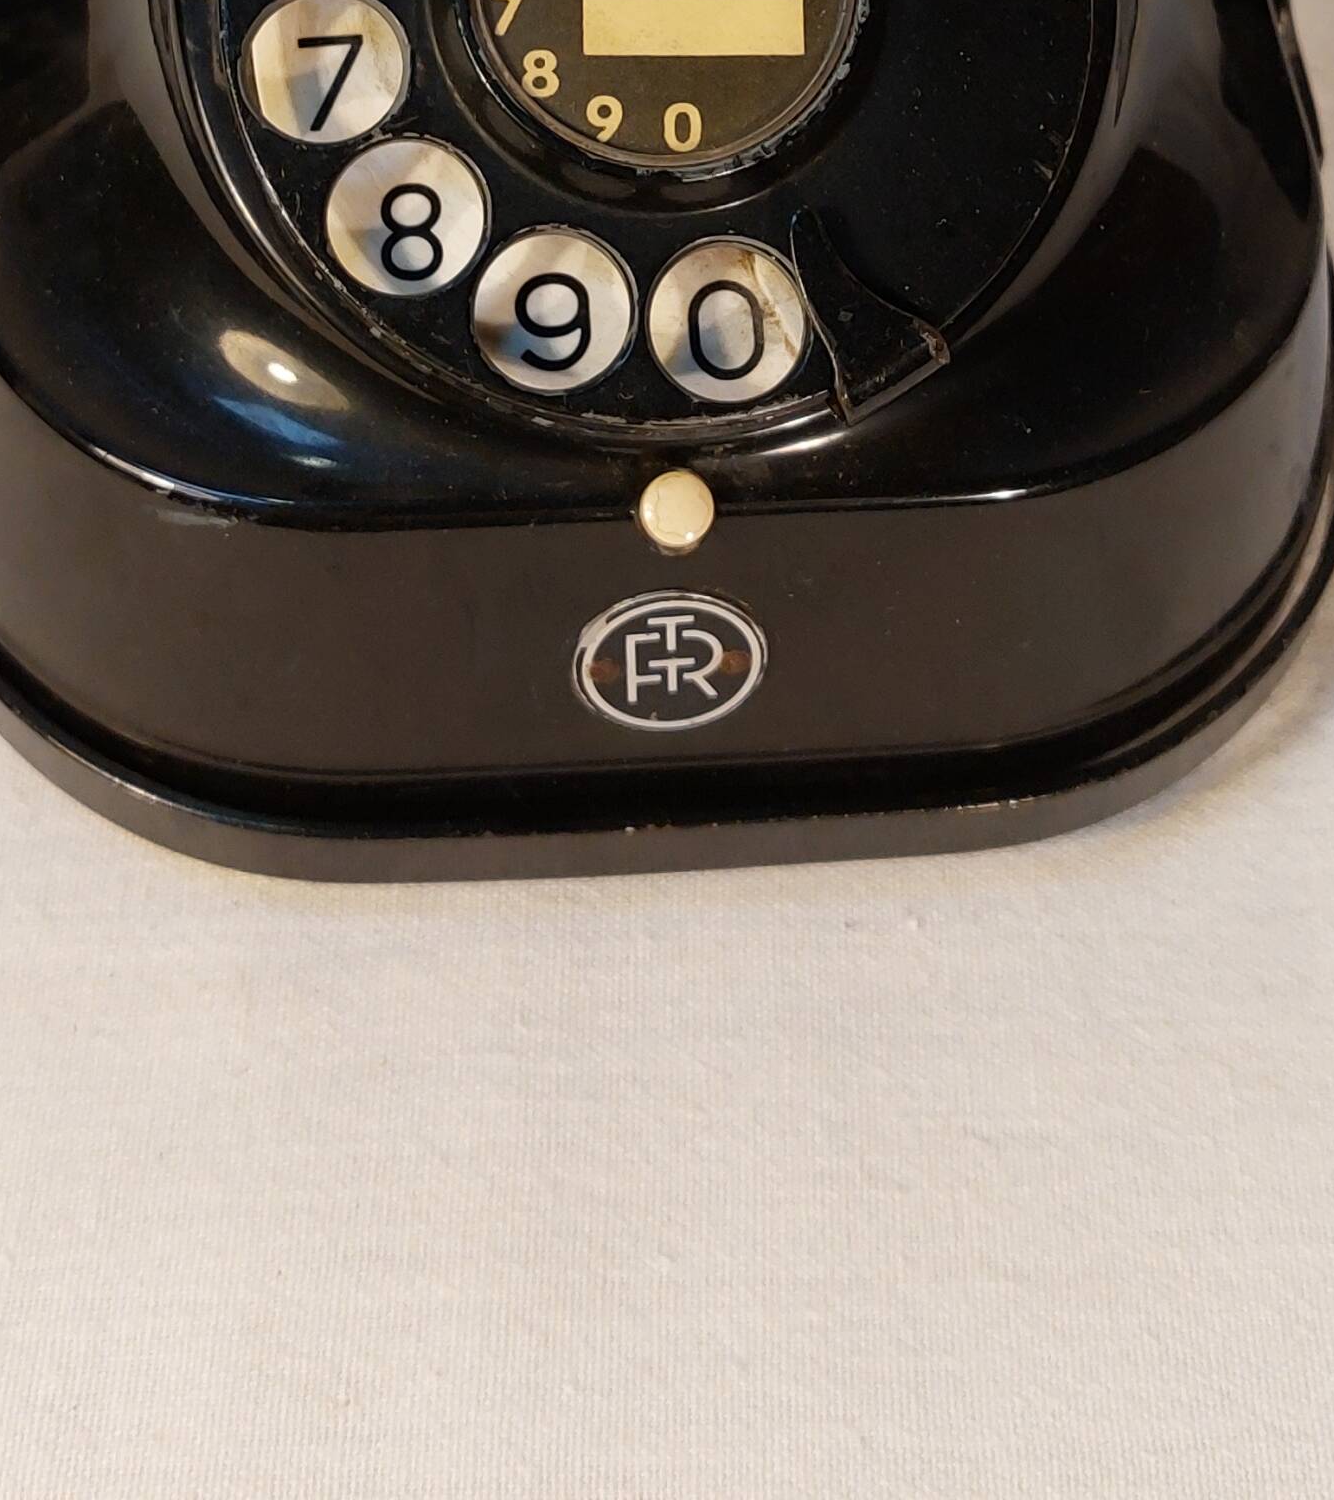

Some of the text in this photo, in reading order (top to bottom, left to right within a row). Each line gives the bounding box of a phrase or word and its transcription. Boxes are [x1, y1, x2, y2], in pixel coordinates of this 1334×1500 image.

[297, 34, 364, 132] 7
[521, 49, 561, 98] 8
[585, 94, 624, 143] 9
[662, 101, 703, 152] 0
[380, 183, 444, 281] 8
[514, 272, 592, 372] 9
[688, 279, 766, 381] 0
